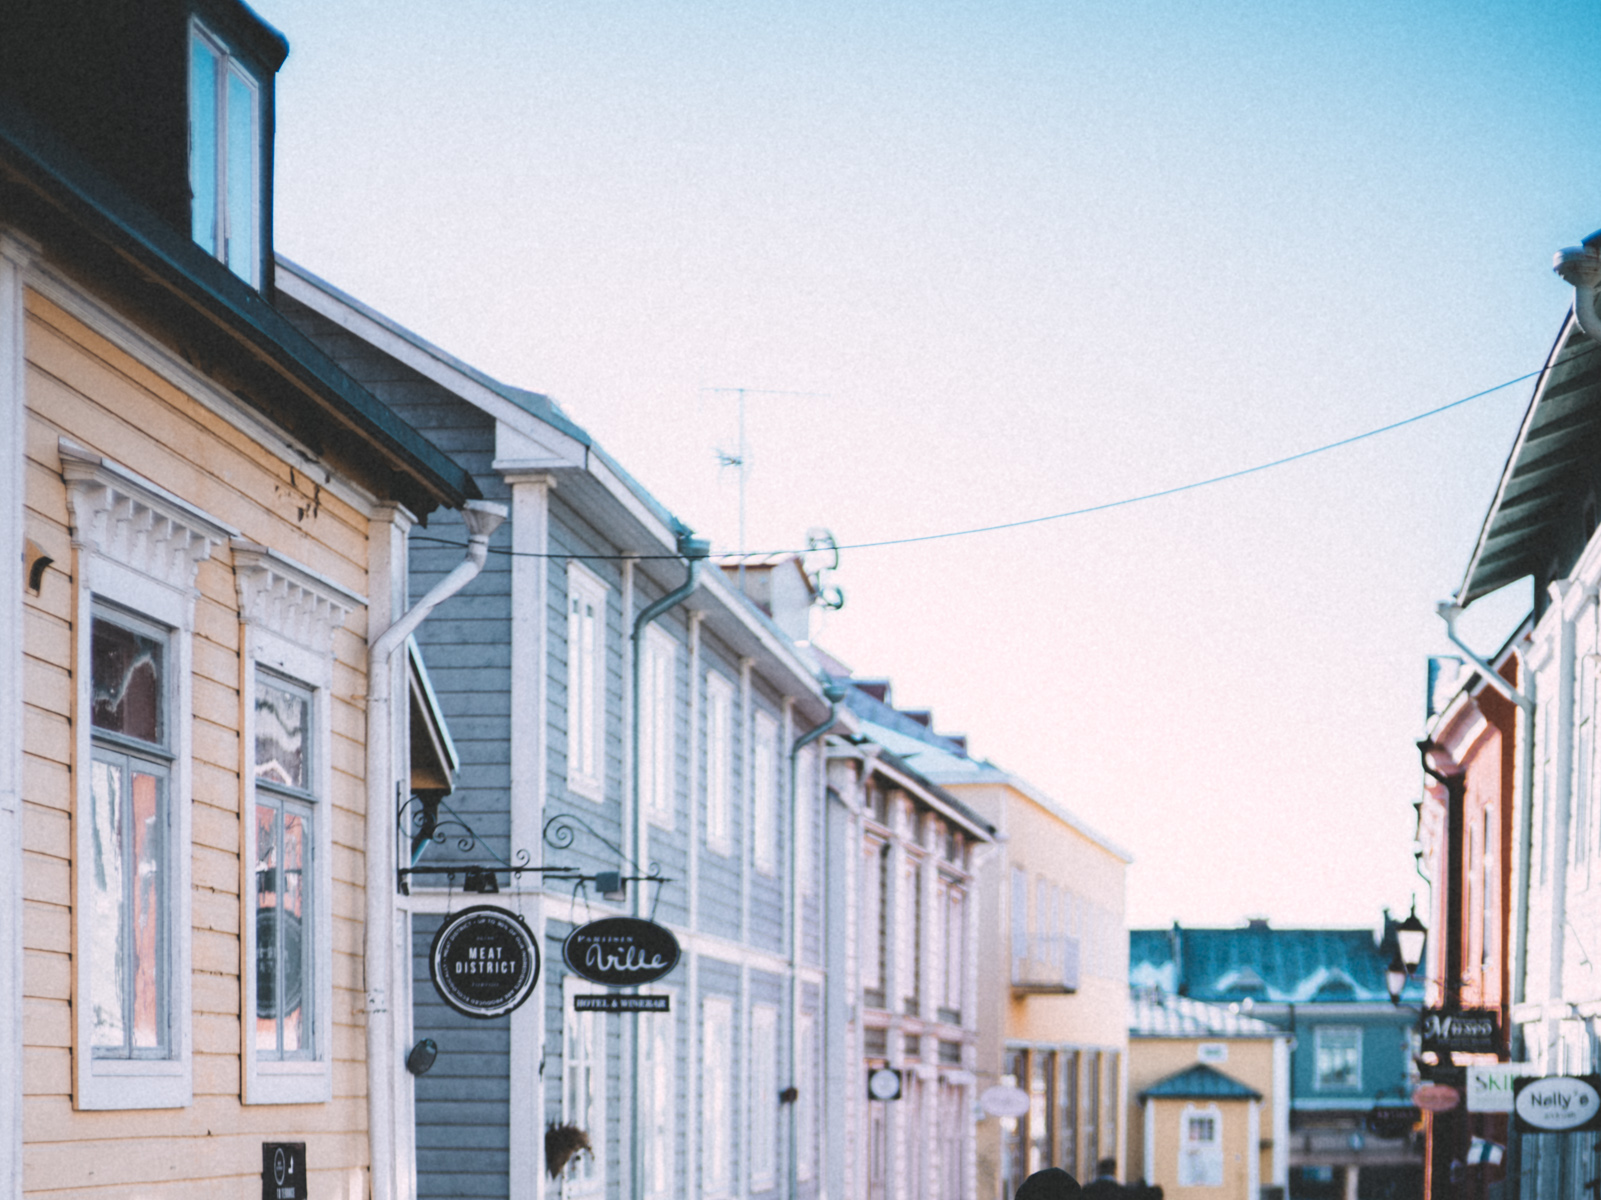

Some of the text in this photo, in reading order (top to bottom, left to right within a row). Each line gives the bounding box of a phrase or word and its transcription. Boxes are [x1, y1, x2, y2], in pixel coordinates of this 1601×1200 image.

[468, 946, 502, 960] MEAT
[586, 943, 668, 971] Ville
[455, 961, 516, 974] DISTRICT
[576, 998, 609, 1008] HOTEL
[611, 999, 618, 1008] &
